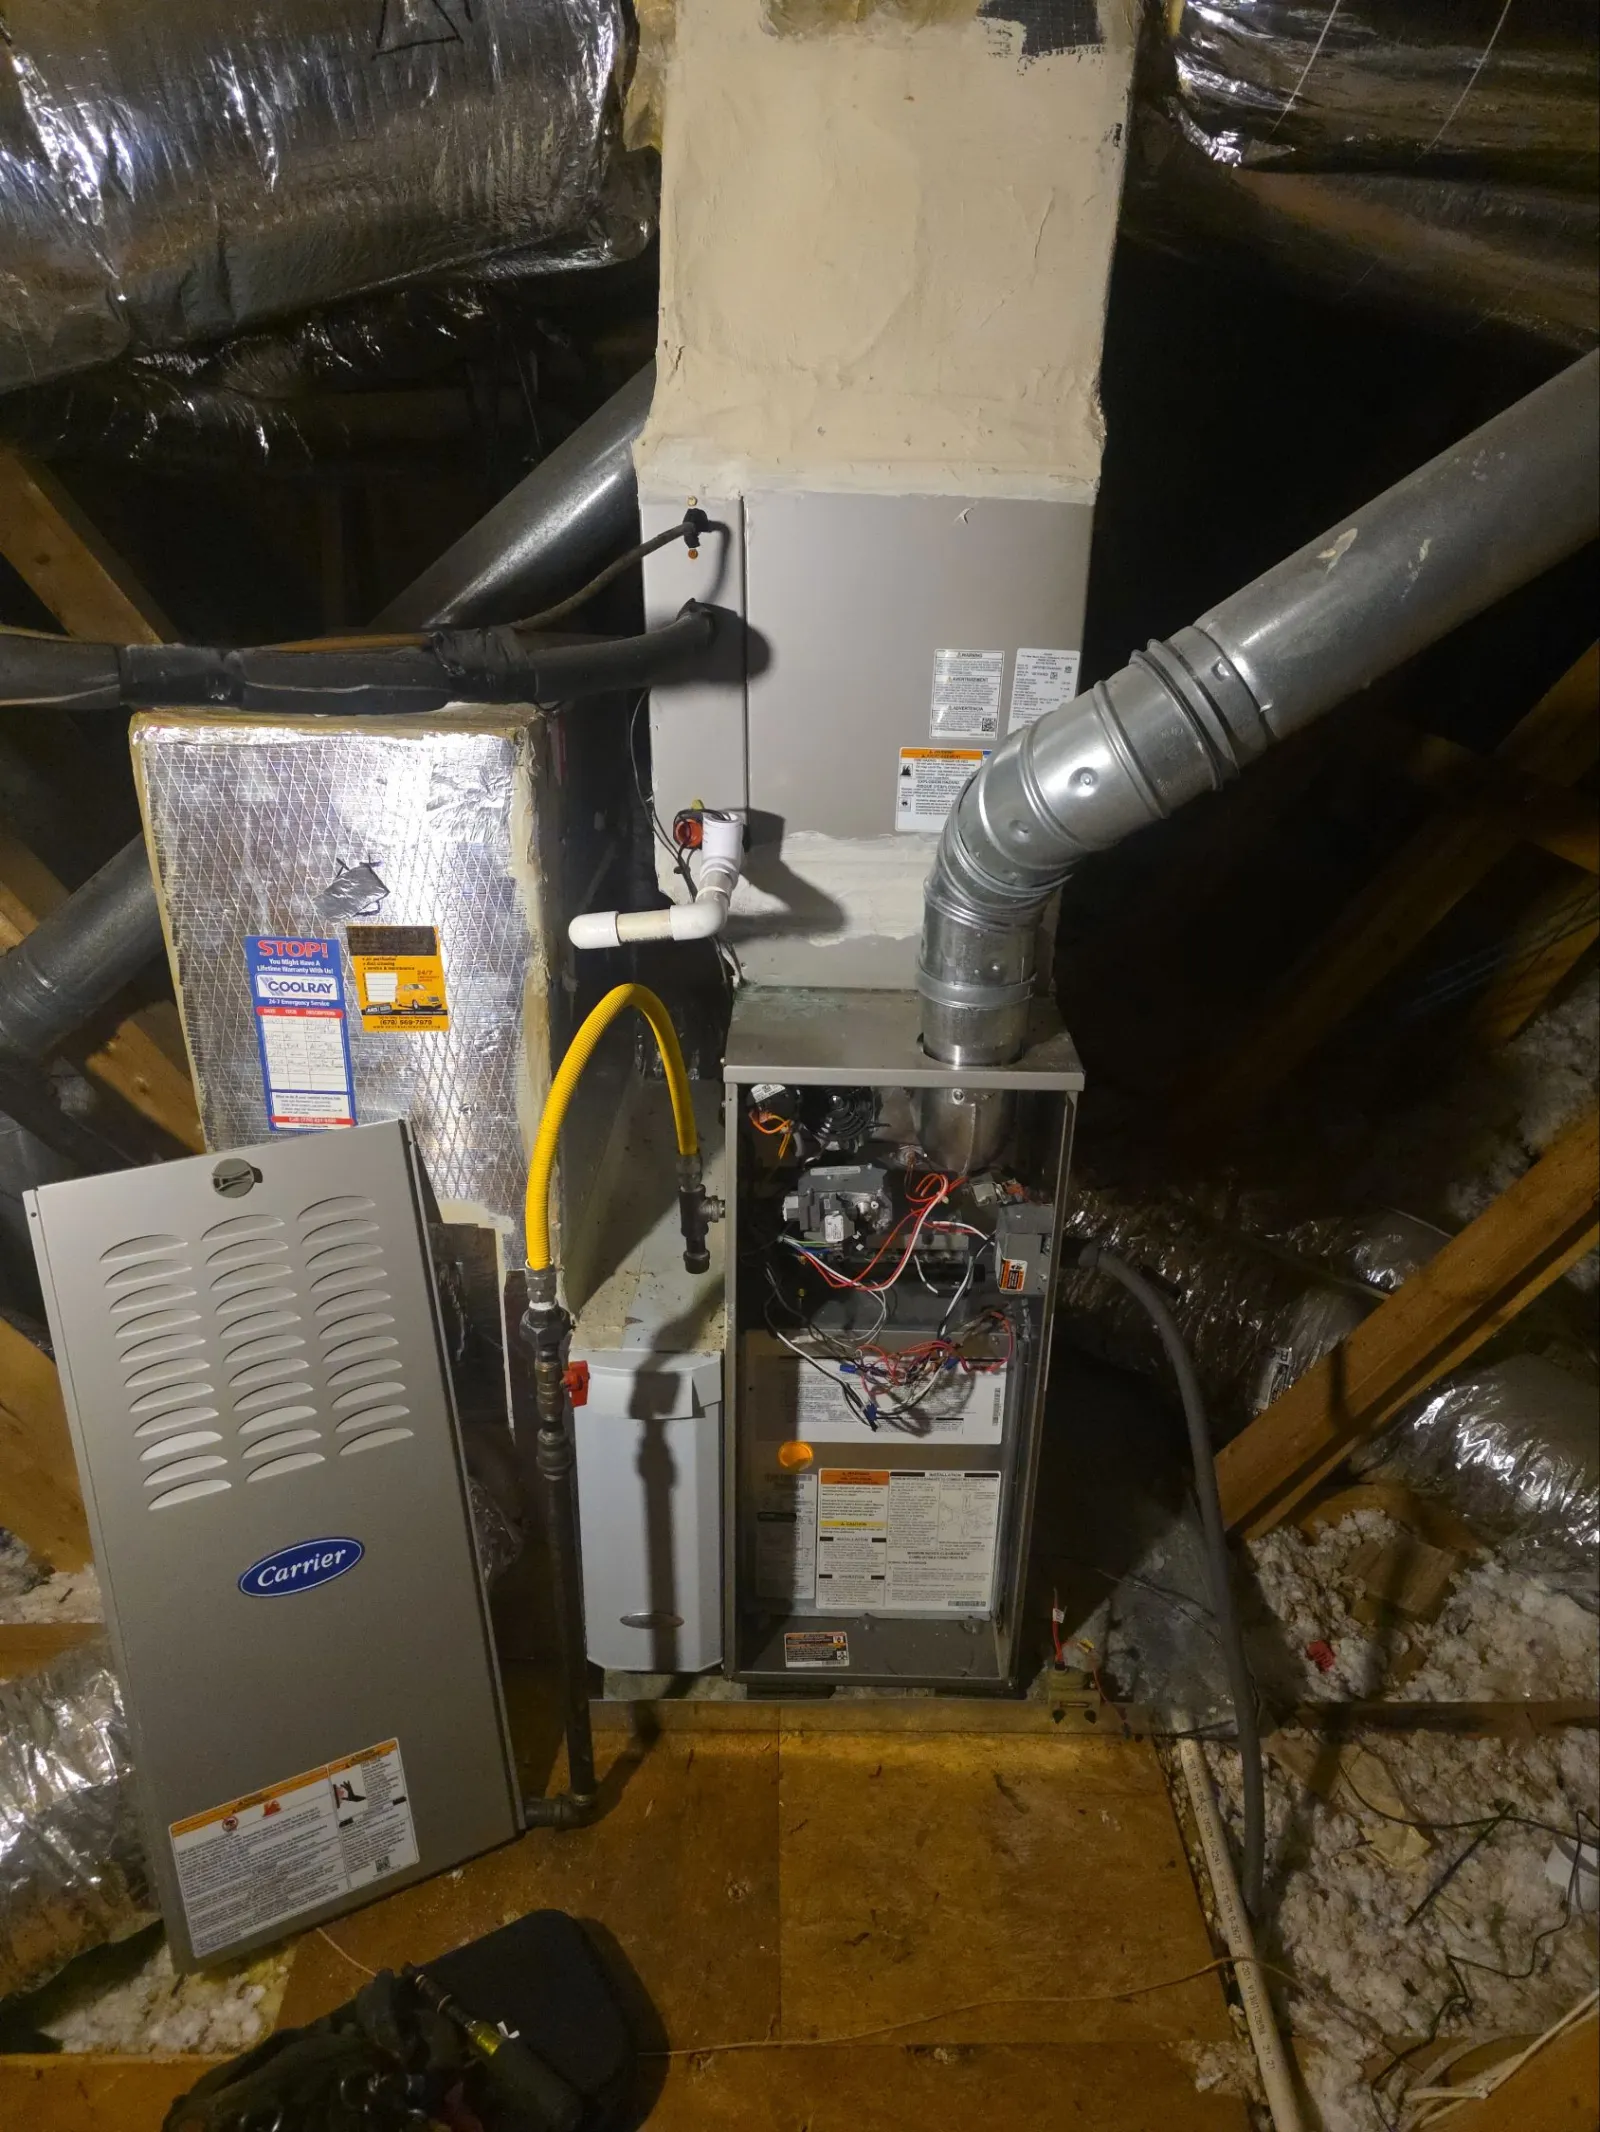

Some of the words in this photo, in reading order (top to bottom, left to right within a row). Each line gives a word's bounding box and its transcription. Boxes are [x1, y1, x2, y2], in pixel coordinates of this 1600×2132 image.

[258, 940, 328, 958] STOP!
[268, 981, 333, 994] COOLRAY
[258, 1550, 346, 1586] Carrier
